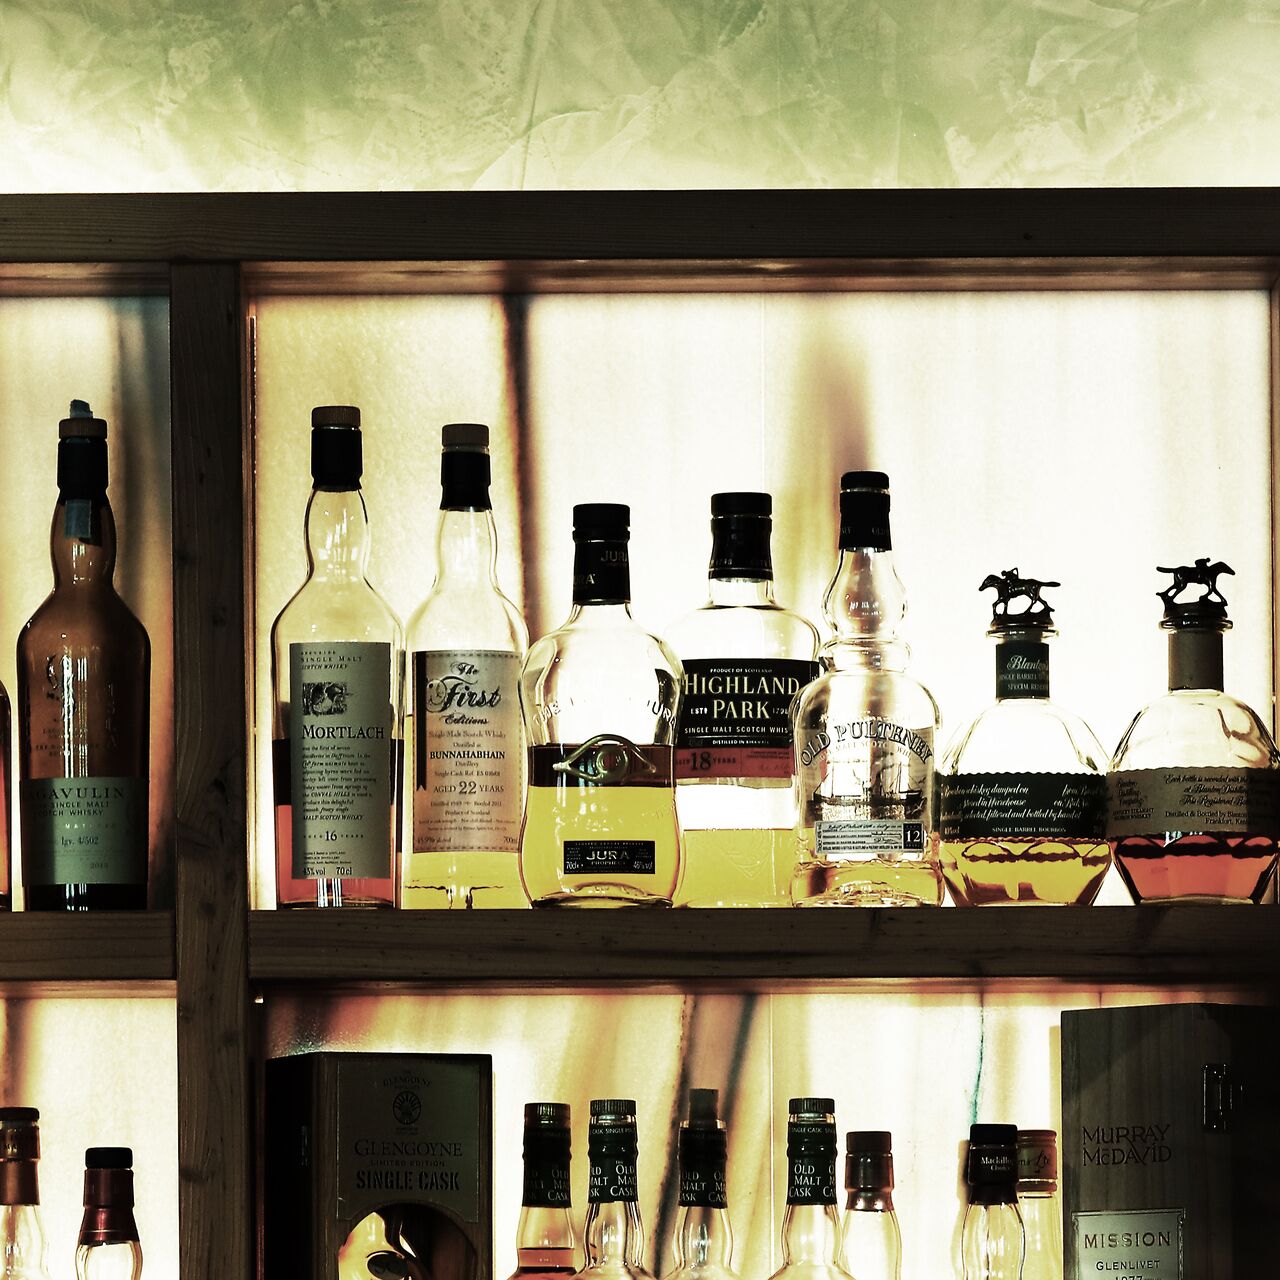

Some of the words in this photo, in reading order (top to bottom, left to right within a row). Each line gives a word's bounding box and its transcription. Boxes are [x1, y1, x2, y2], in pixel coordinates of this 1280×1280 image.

[450, 662, 479, 677] The
[683, 674, 800, 695] HIGHLAND
[426, 676, 501, 713] First
[713, 700, 770, 719] PARK
[441, 714, 489, 725] Editions
[302, 725, 384, 738] MORTLACH
[801, 732, 831, 766] OLD
[835, 722, 932, 764] PULTENEY
[430, 751, 505, 760] BUNNAHABHAIN
[691, 752, 711, 771] 18
[434, 785, 456, 793] AGED
[459, 781, 476, 795] 22
[325, 831, 337, 841] 16
[907, 831, 920, 842] 12
[1082, 1125, 1171, 1146] MURRAY
[354, 1141, 462, 1157] GLENGOYNE
[356, 1171, 412, 1190] SINGLE
[420, 1171, 459, 1190] CASK
[1084, 1231, 1171, 1249] MISSION
[1096, 1259, 1161, 1270] GLENLIVET
